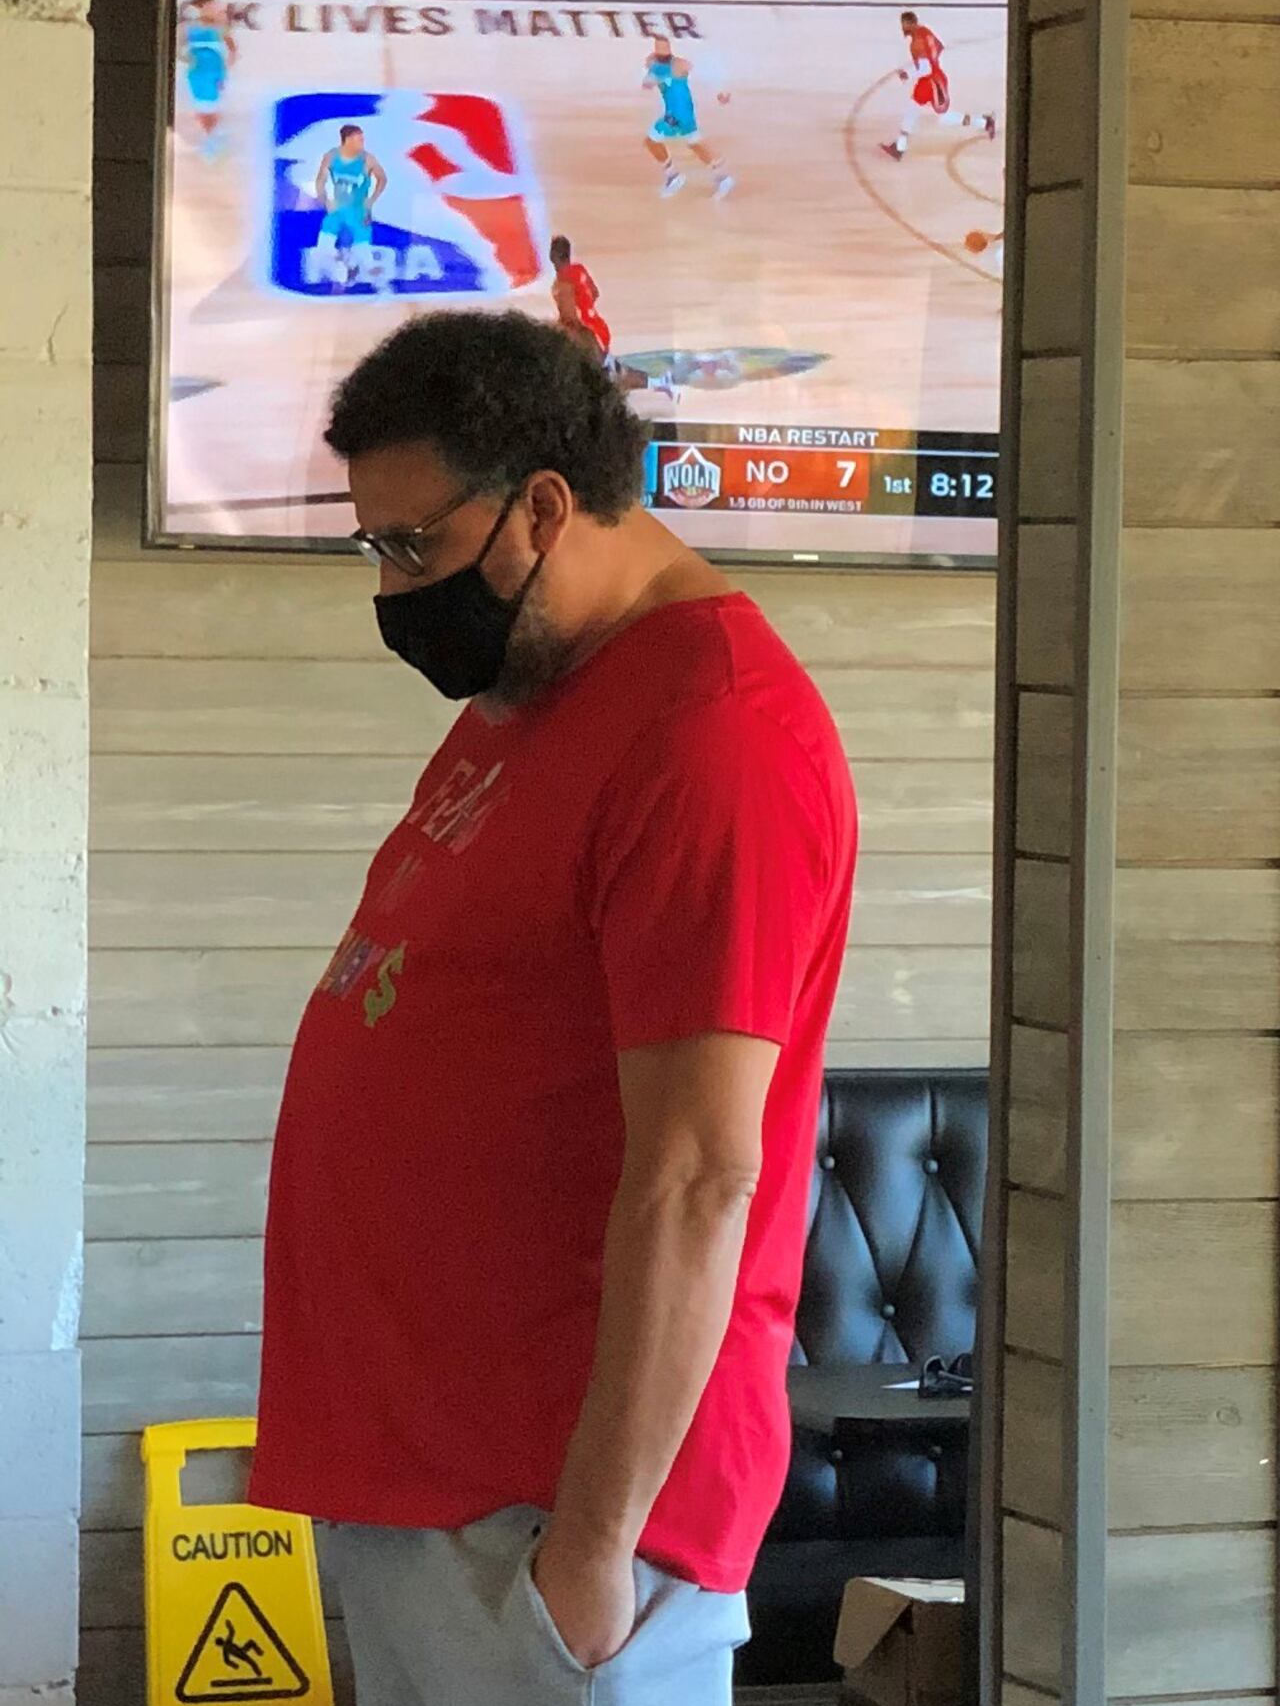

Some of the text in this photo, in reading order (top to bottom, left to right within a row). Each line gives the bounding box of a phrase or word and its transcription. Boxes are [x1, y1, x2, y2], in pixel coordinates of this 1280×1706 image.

[286, 3, 454, 36] LIVES
[474, 6, 703, 40] MATTER
[738, 426, 880, 448] NBA RESTART
[745, 460, 790, 484] NO
[835, 460, 857, 489] 7
[883, 475, 912, 495] 1st
[929, 473, 994, 499] 8:12
[171, 1530, 293, 1562] CAUTION
